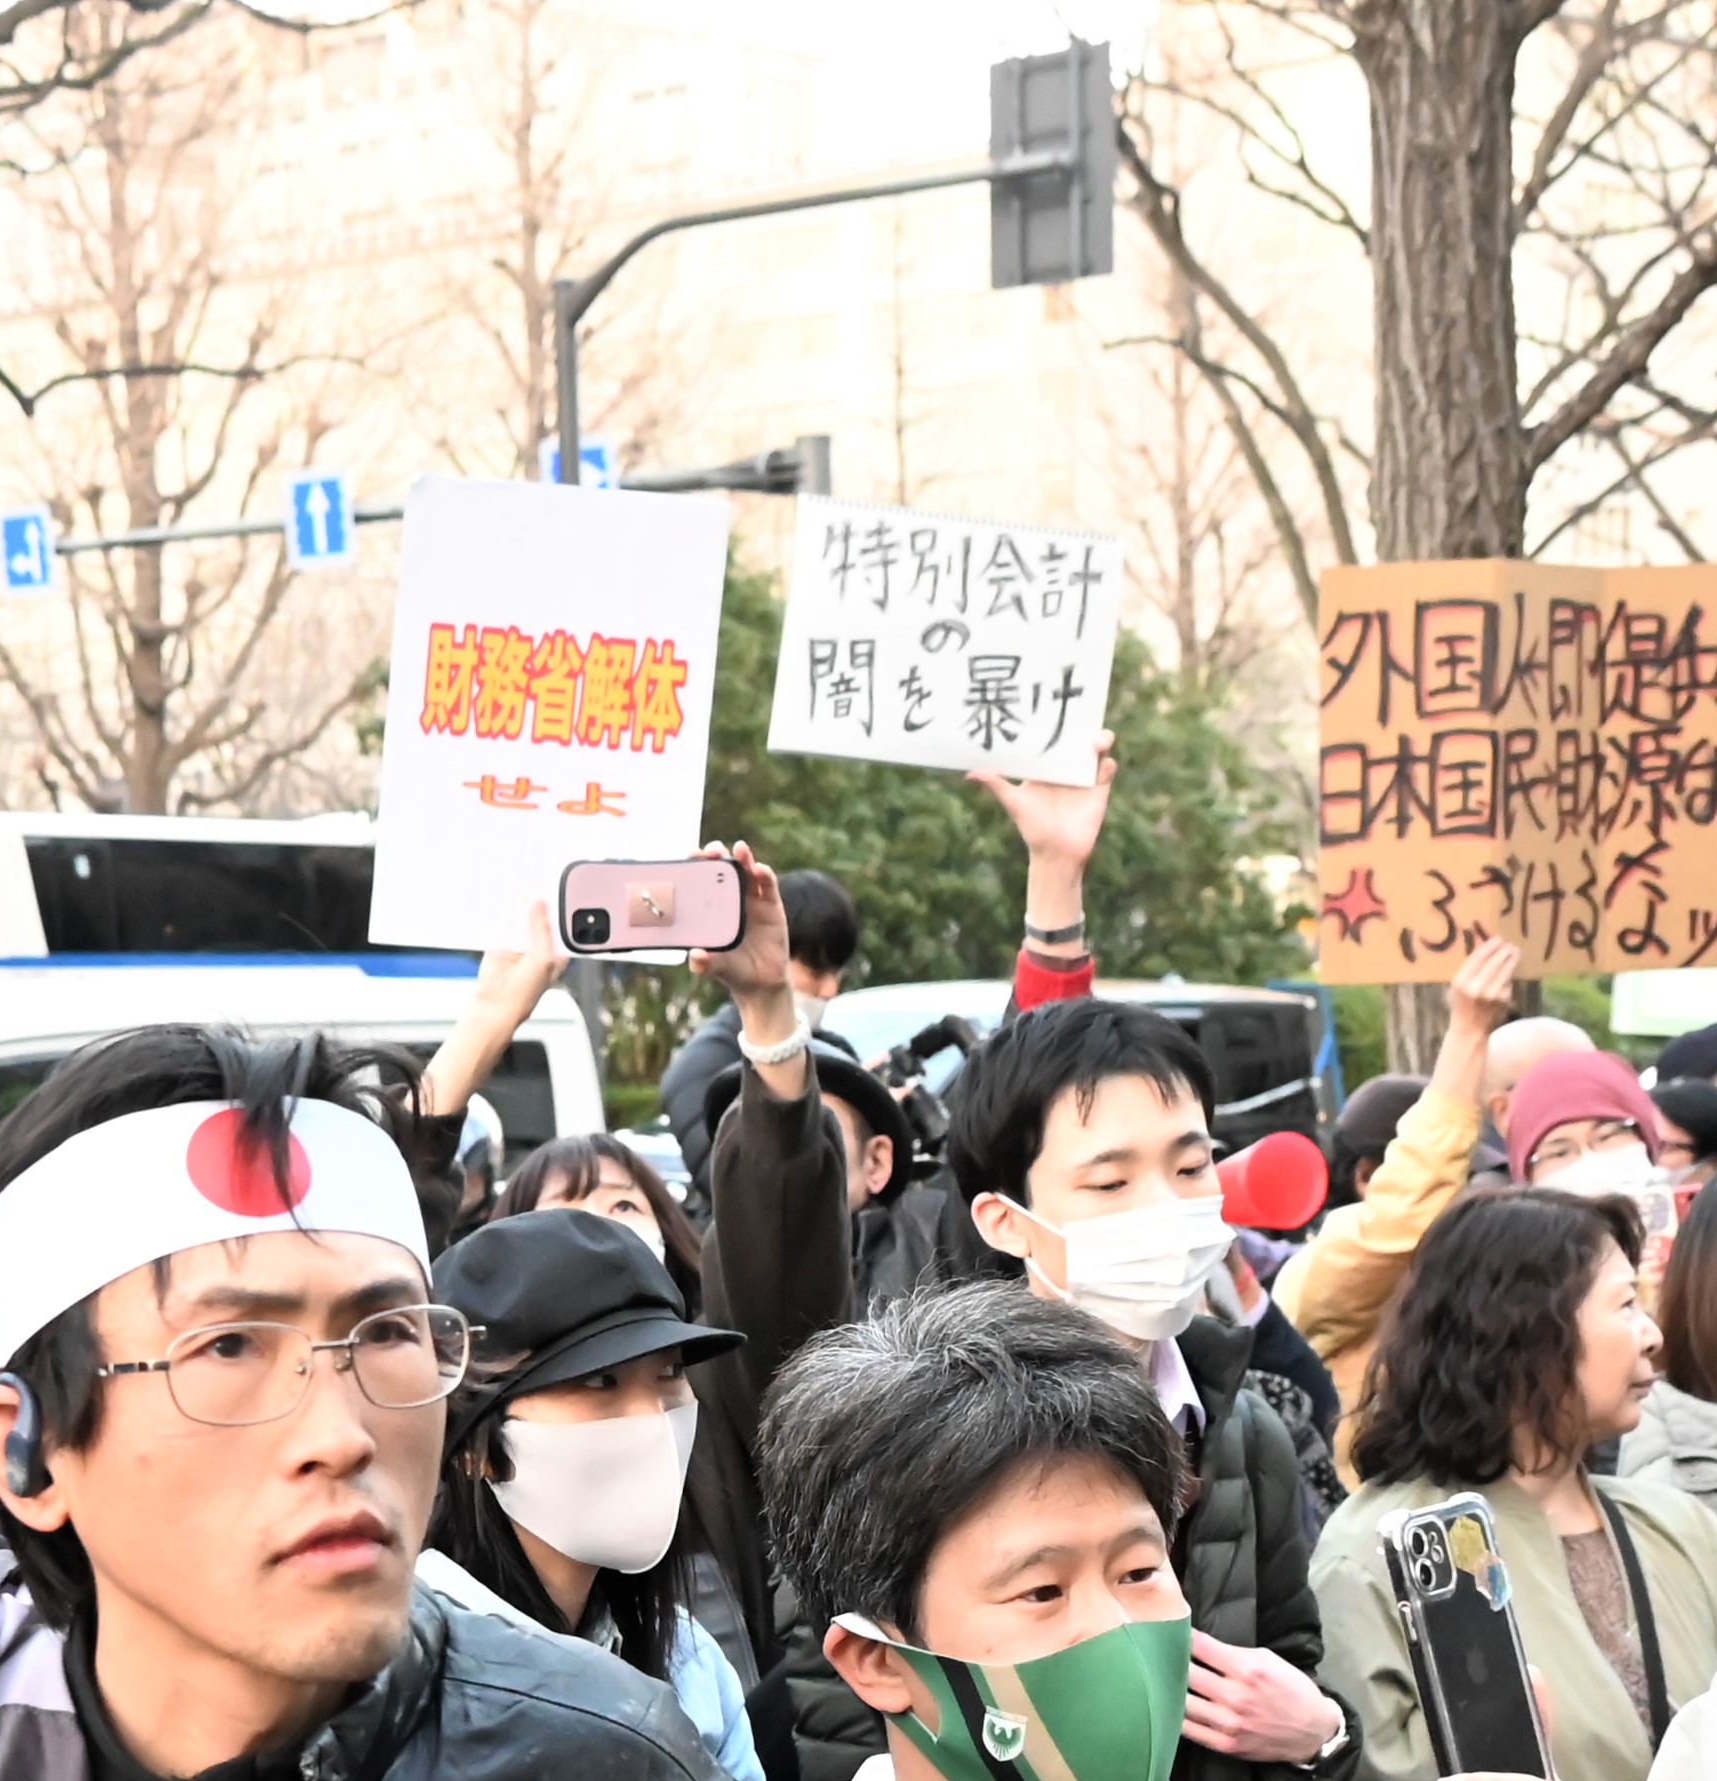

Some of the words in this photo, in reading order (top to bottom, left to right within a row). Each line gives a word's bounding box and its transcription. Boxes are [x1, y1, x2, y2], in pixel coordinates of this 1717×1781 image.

[822, 518, 1103, 642] 特別会計
[920, 617, 971, 656] の
[419, 622, 689, 755] 財務省解体
[807, 637, 1085, 754] 闇を暴け
[463, 774, 628, 817] せよ
